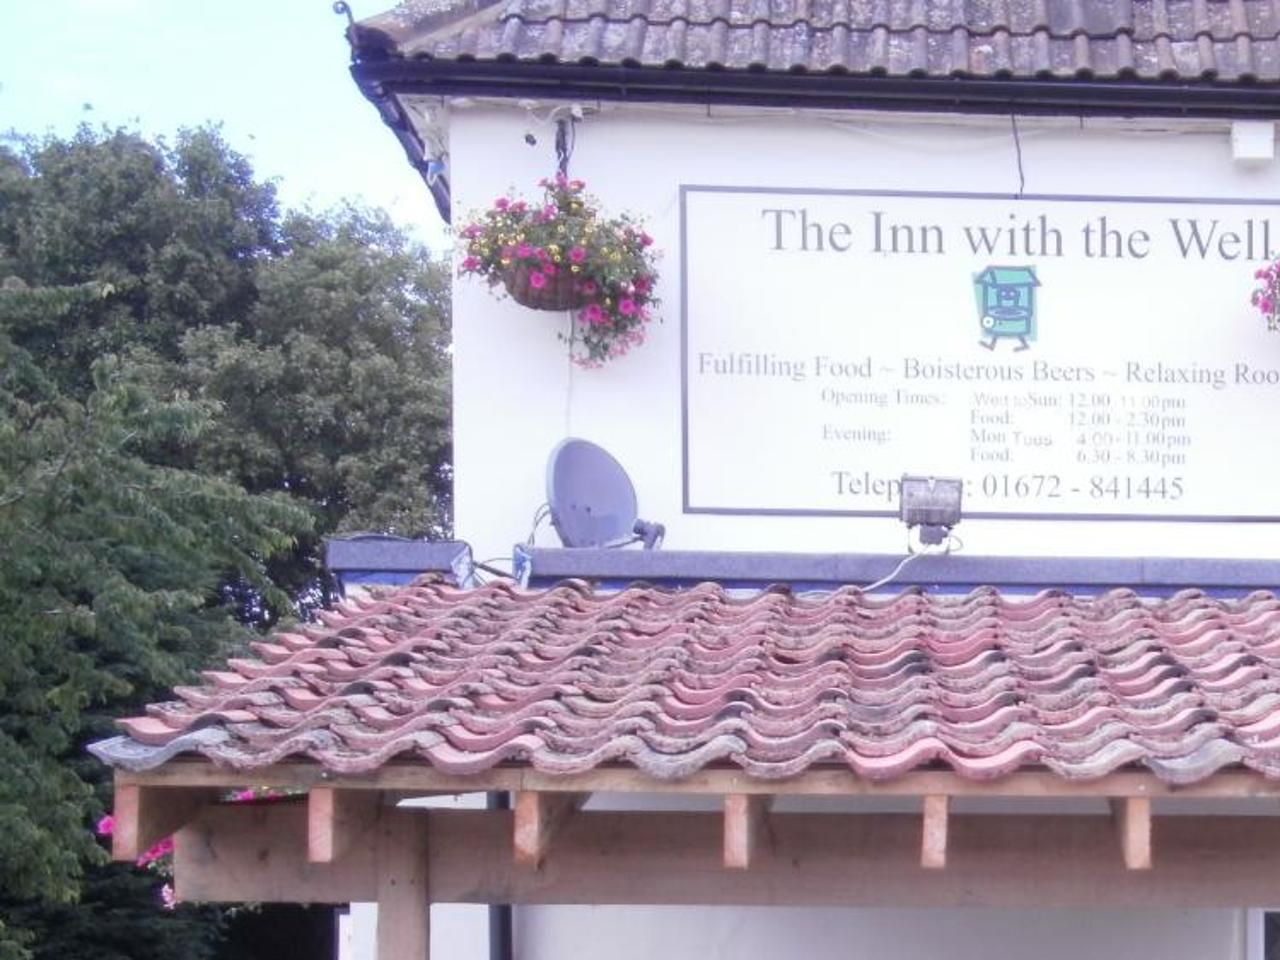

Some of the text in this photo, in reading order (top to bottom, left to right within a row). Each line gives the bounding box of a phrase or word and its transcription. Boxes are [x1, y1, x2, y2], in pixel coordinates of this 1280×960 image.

[762, 208, 1273, 261] The Inn with the Well
[698, 353, 807, 382] Fulfilling
[814, 356, 872, 379] Food
[904, 357, 1024, 381] Boisterous
[1032, 360, 1095, 382] Beers
[1126, 361, 1227, 388] Relaxing
[820, 388, 945, 408] Opening Times:
[822, 424, 893, 444] Evening:
[982, 474, 1061, 498] 01672
[1089, 476, 1183, 500] 841445
